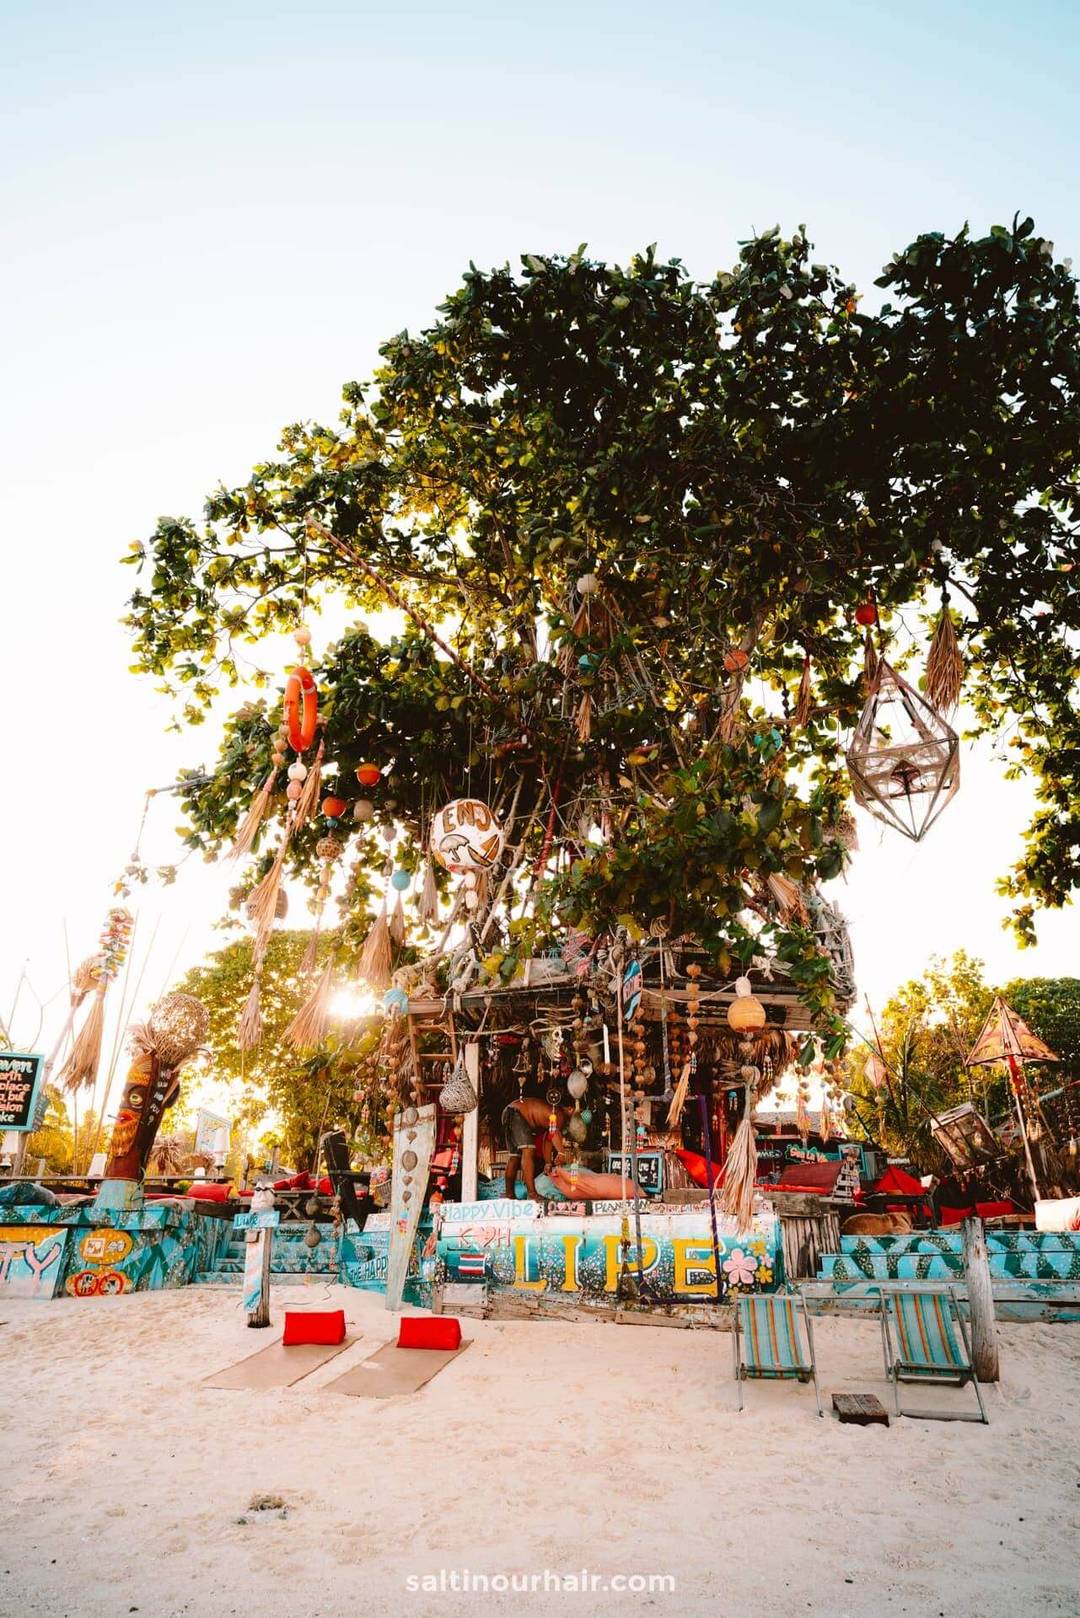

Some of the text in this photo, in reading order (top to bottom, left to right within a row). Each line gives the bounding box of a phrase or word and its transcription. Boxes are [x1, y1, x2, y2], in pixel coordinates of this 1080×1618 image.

[492, 1200, 535, 1218] Vibe
[279, 1227, 306, 1235] welcom
[364, 1255, 390, 1280] HAPP
[512, 1235, 724, 1298] LIPE
